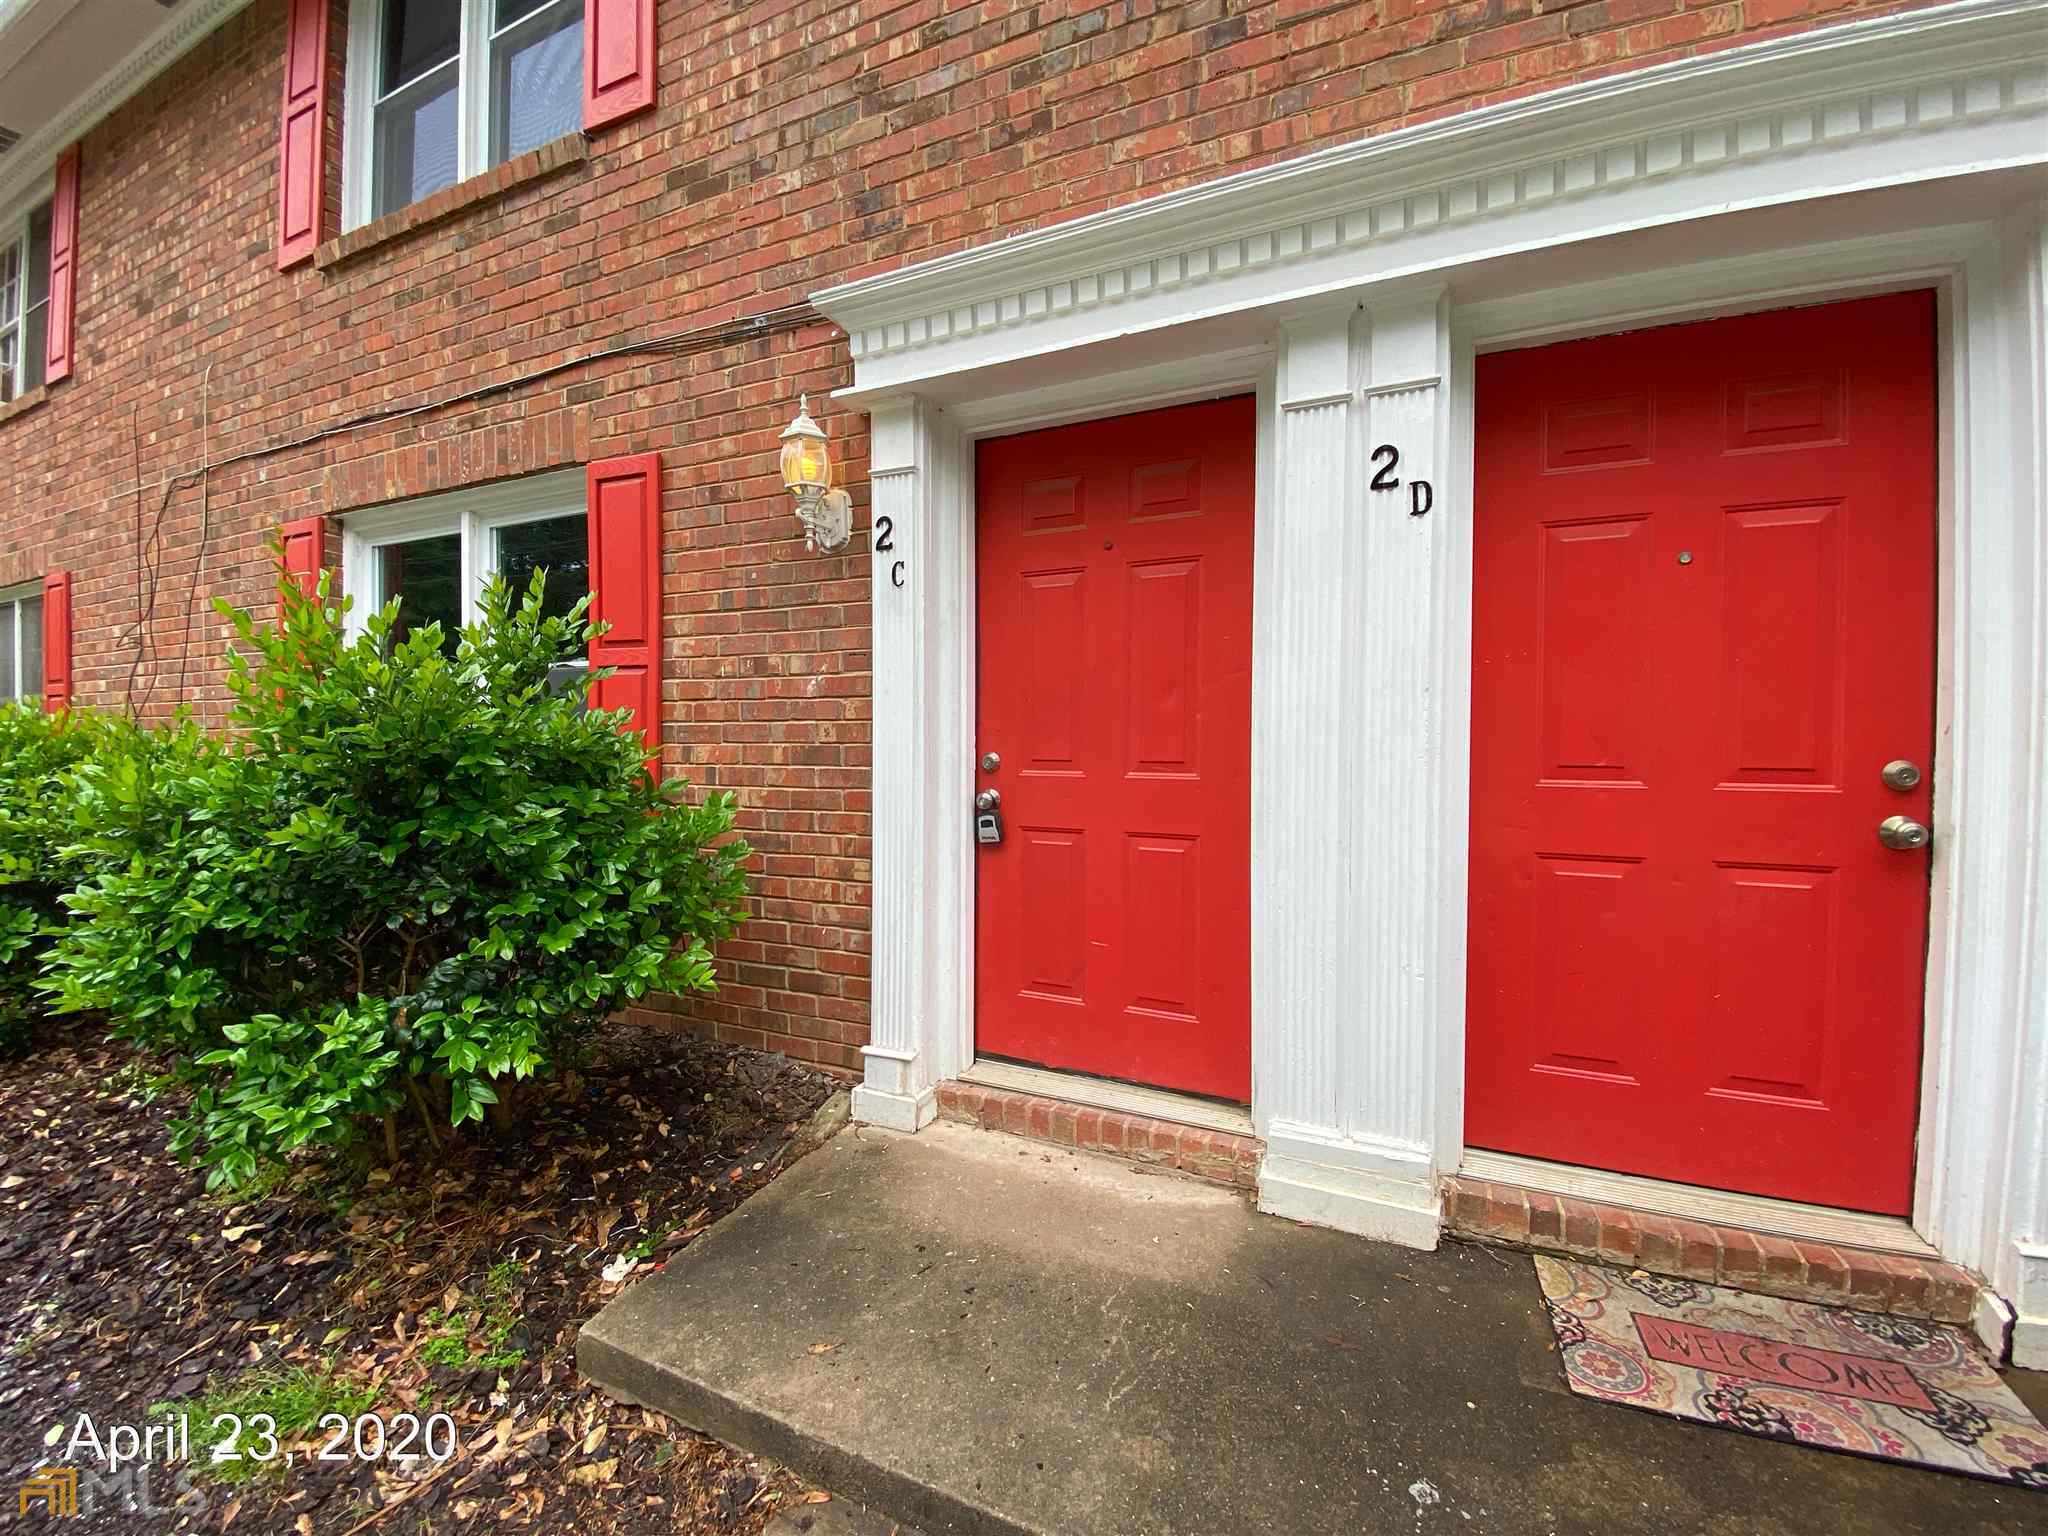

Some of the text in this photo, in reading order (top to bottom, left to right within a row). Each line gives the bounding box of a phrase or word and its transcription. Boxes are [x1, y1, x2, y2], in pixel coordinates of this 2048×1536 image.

[1370, 444, 1433, 517] 2 D
[875, 516, 905, 587] 2 C
[1651, 1324, 1916, 1401] WELCOME
